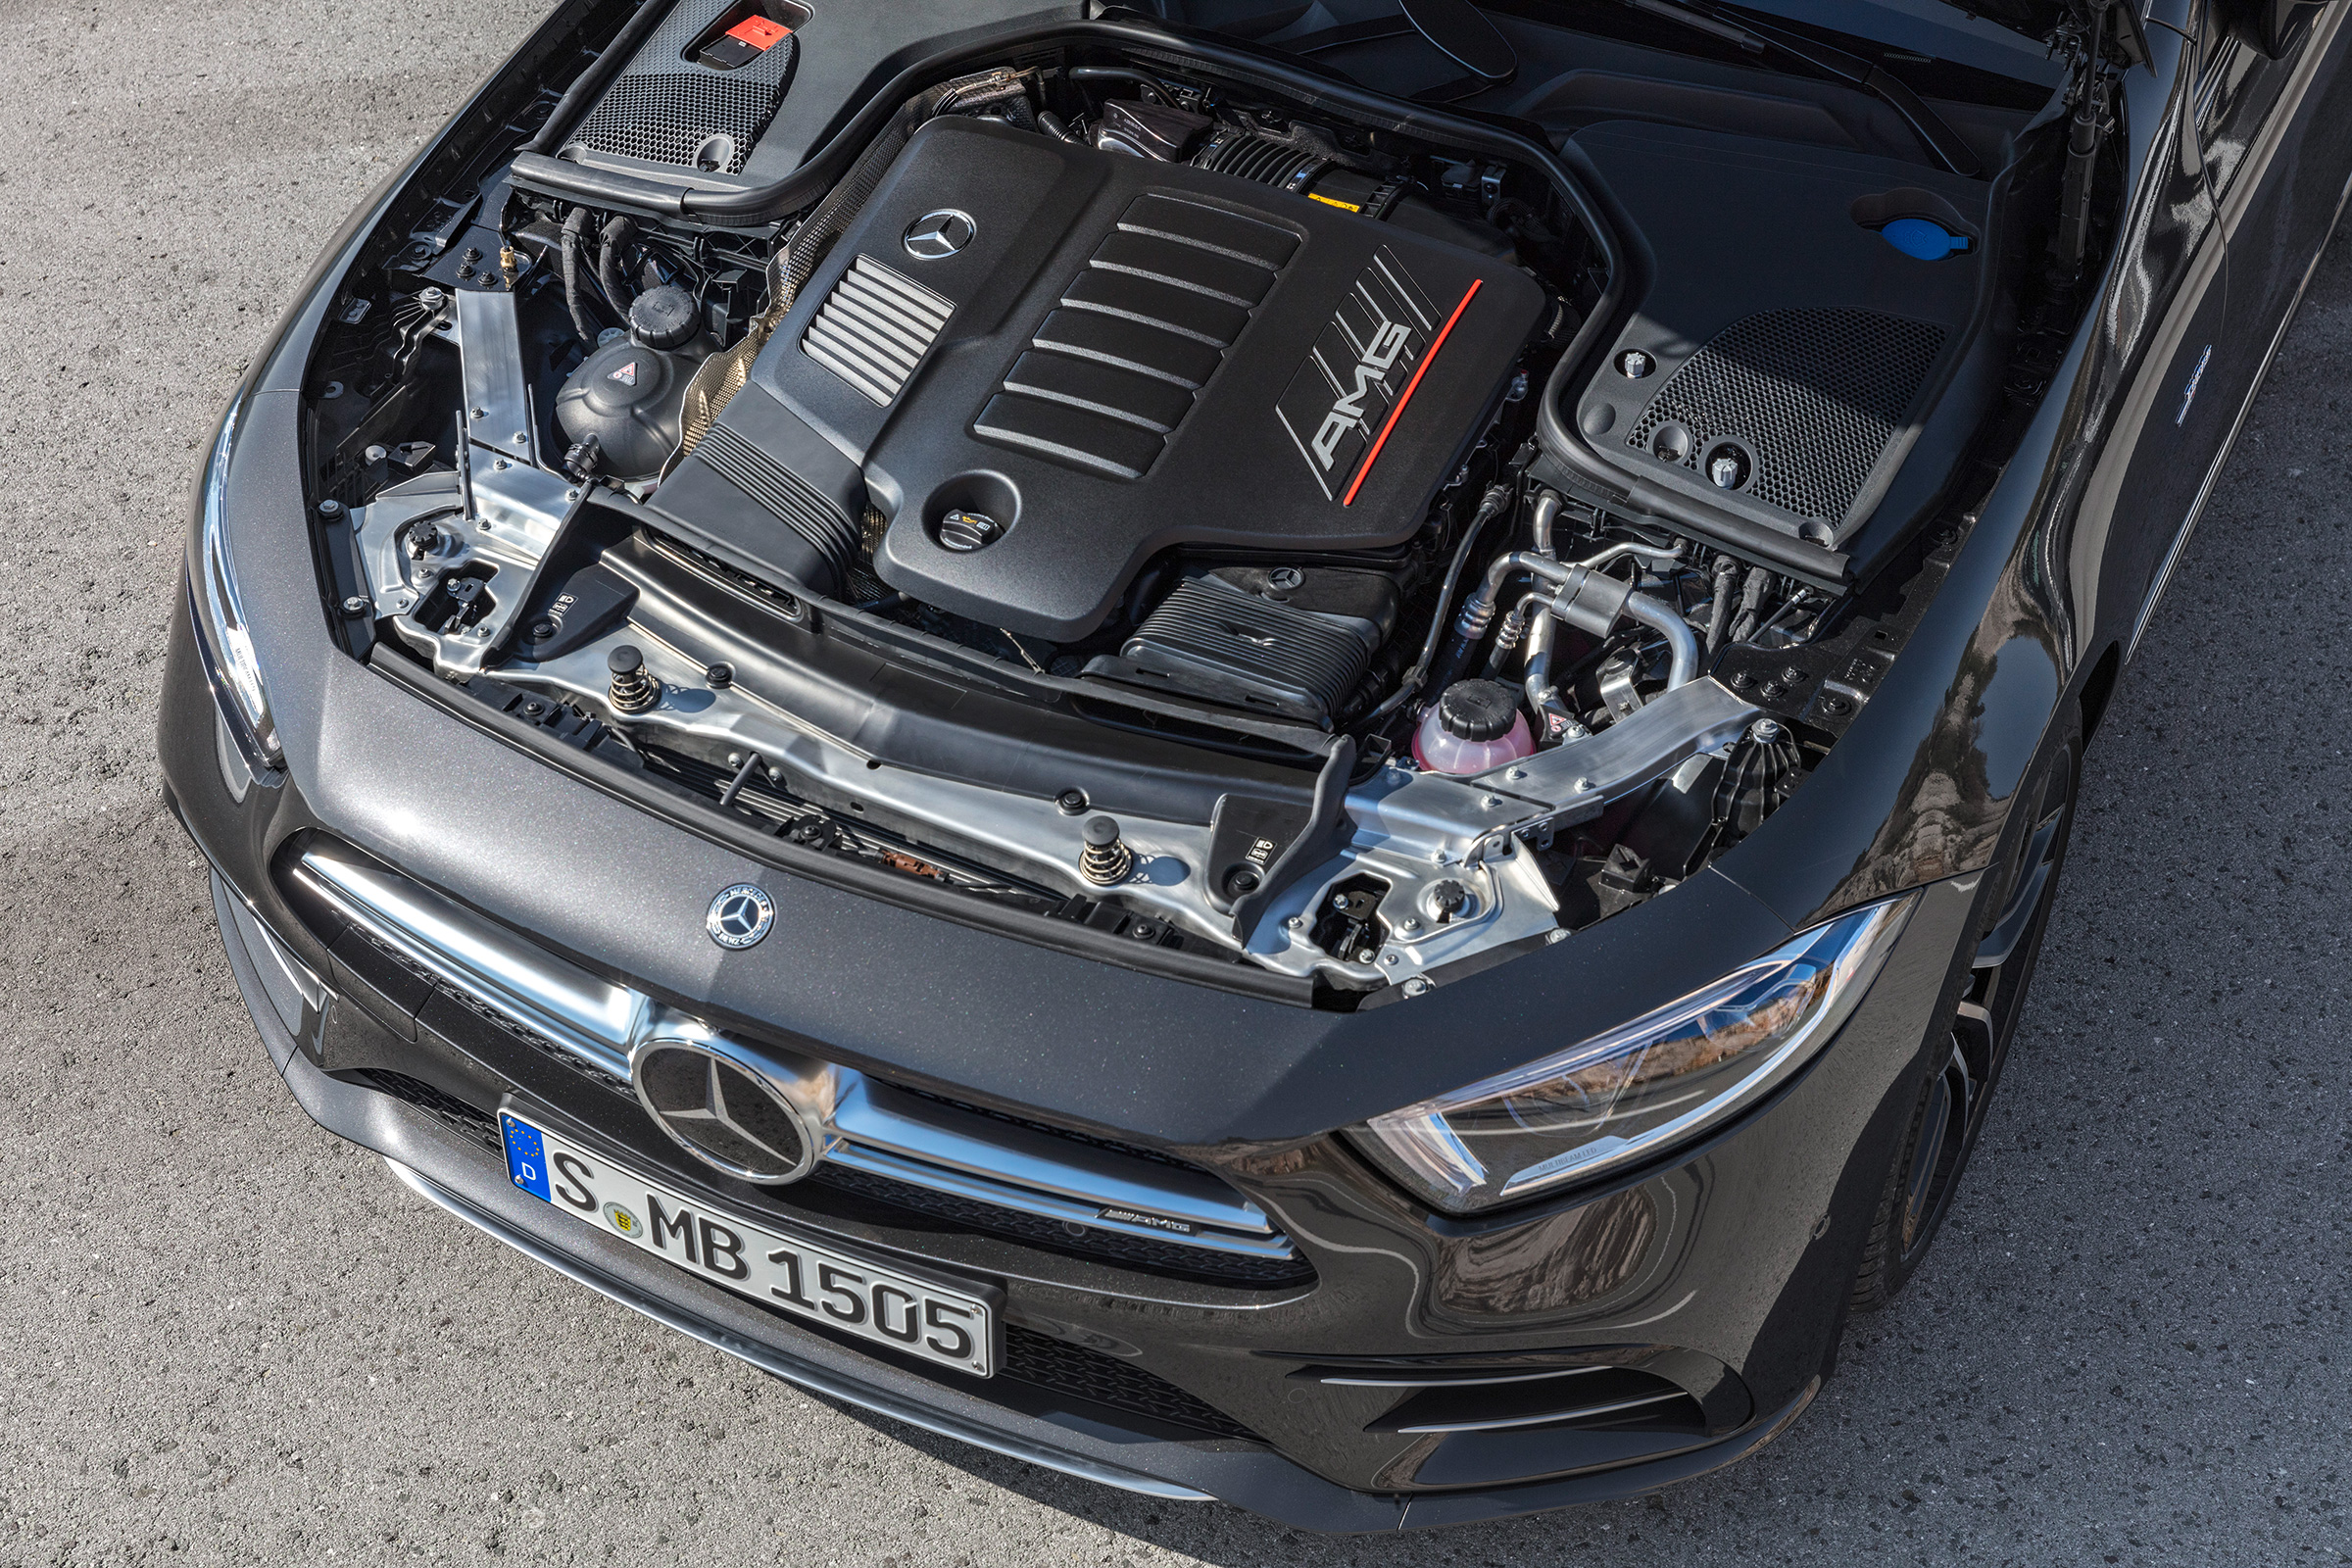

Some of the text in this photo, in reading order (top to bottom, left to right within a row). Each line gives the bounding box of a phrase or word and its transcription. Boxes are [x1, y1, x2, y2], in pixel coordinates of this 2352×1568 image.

[1311, 320, 1412, 472] AMG
[521, 1161, 537, 1181] D
[1539, 1152, 1582, 1172] MULTIBEAM
[1130, 1213, 1191, 1233] AMG
[552, 1151, 598, 1213] S
[646, 1193, 750, 1281] MB
[767, 1250, 972, 1359] 1505
